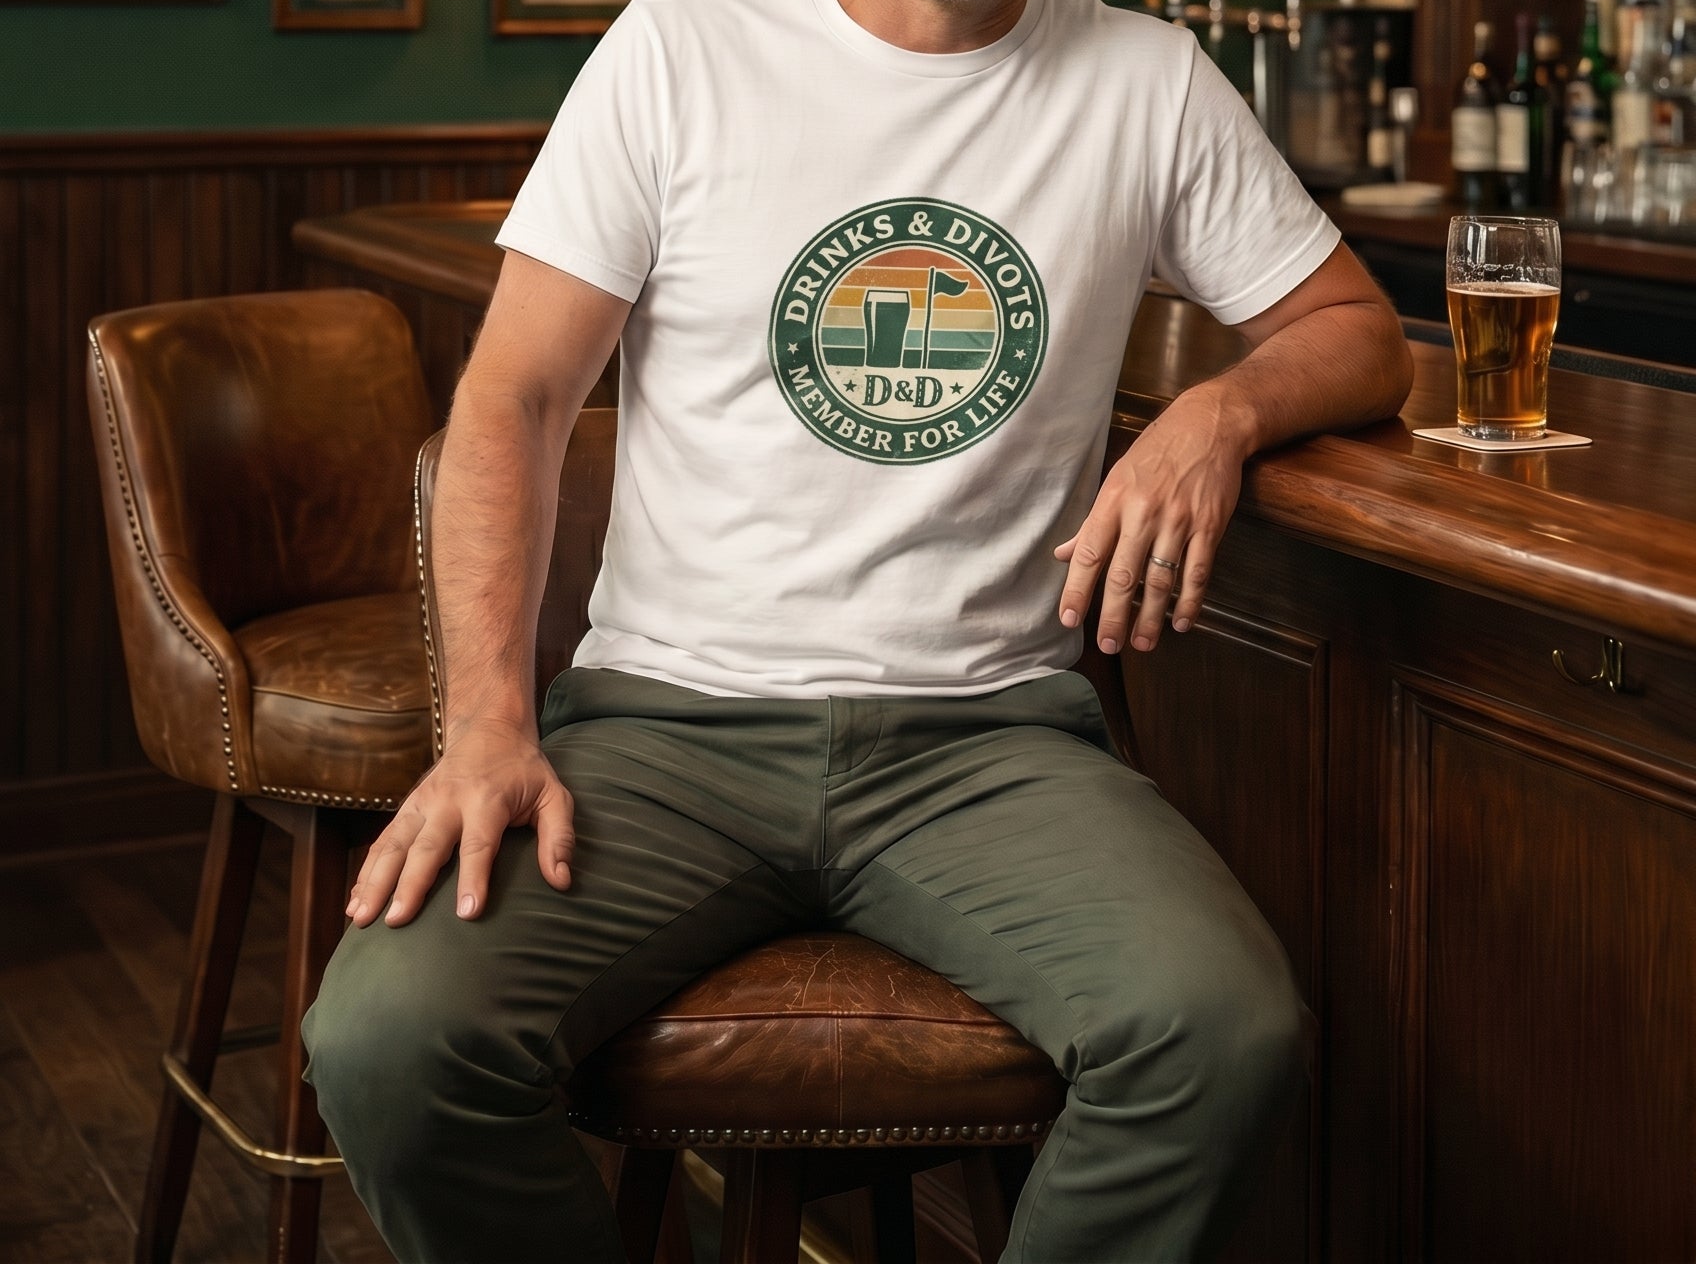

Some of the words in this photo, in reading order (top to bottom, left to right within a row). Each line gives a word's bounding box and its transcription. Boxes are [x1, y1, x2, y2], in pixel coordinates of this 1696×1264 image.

[785, 215, 894, 324] DRINKS
[908, 211, 933, 237] &
[945, 219, 1034, 329] DIVOTS
[789, 366, 892, 452] MEMBER
[904, 420, 965, 452] FOR
[966, 370, 1020, 428] LIFE
[862, 374, 943, 408] D&D
